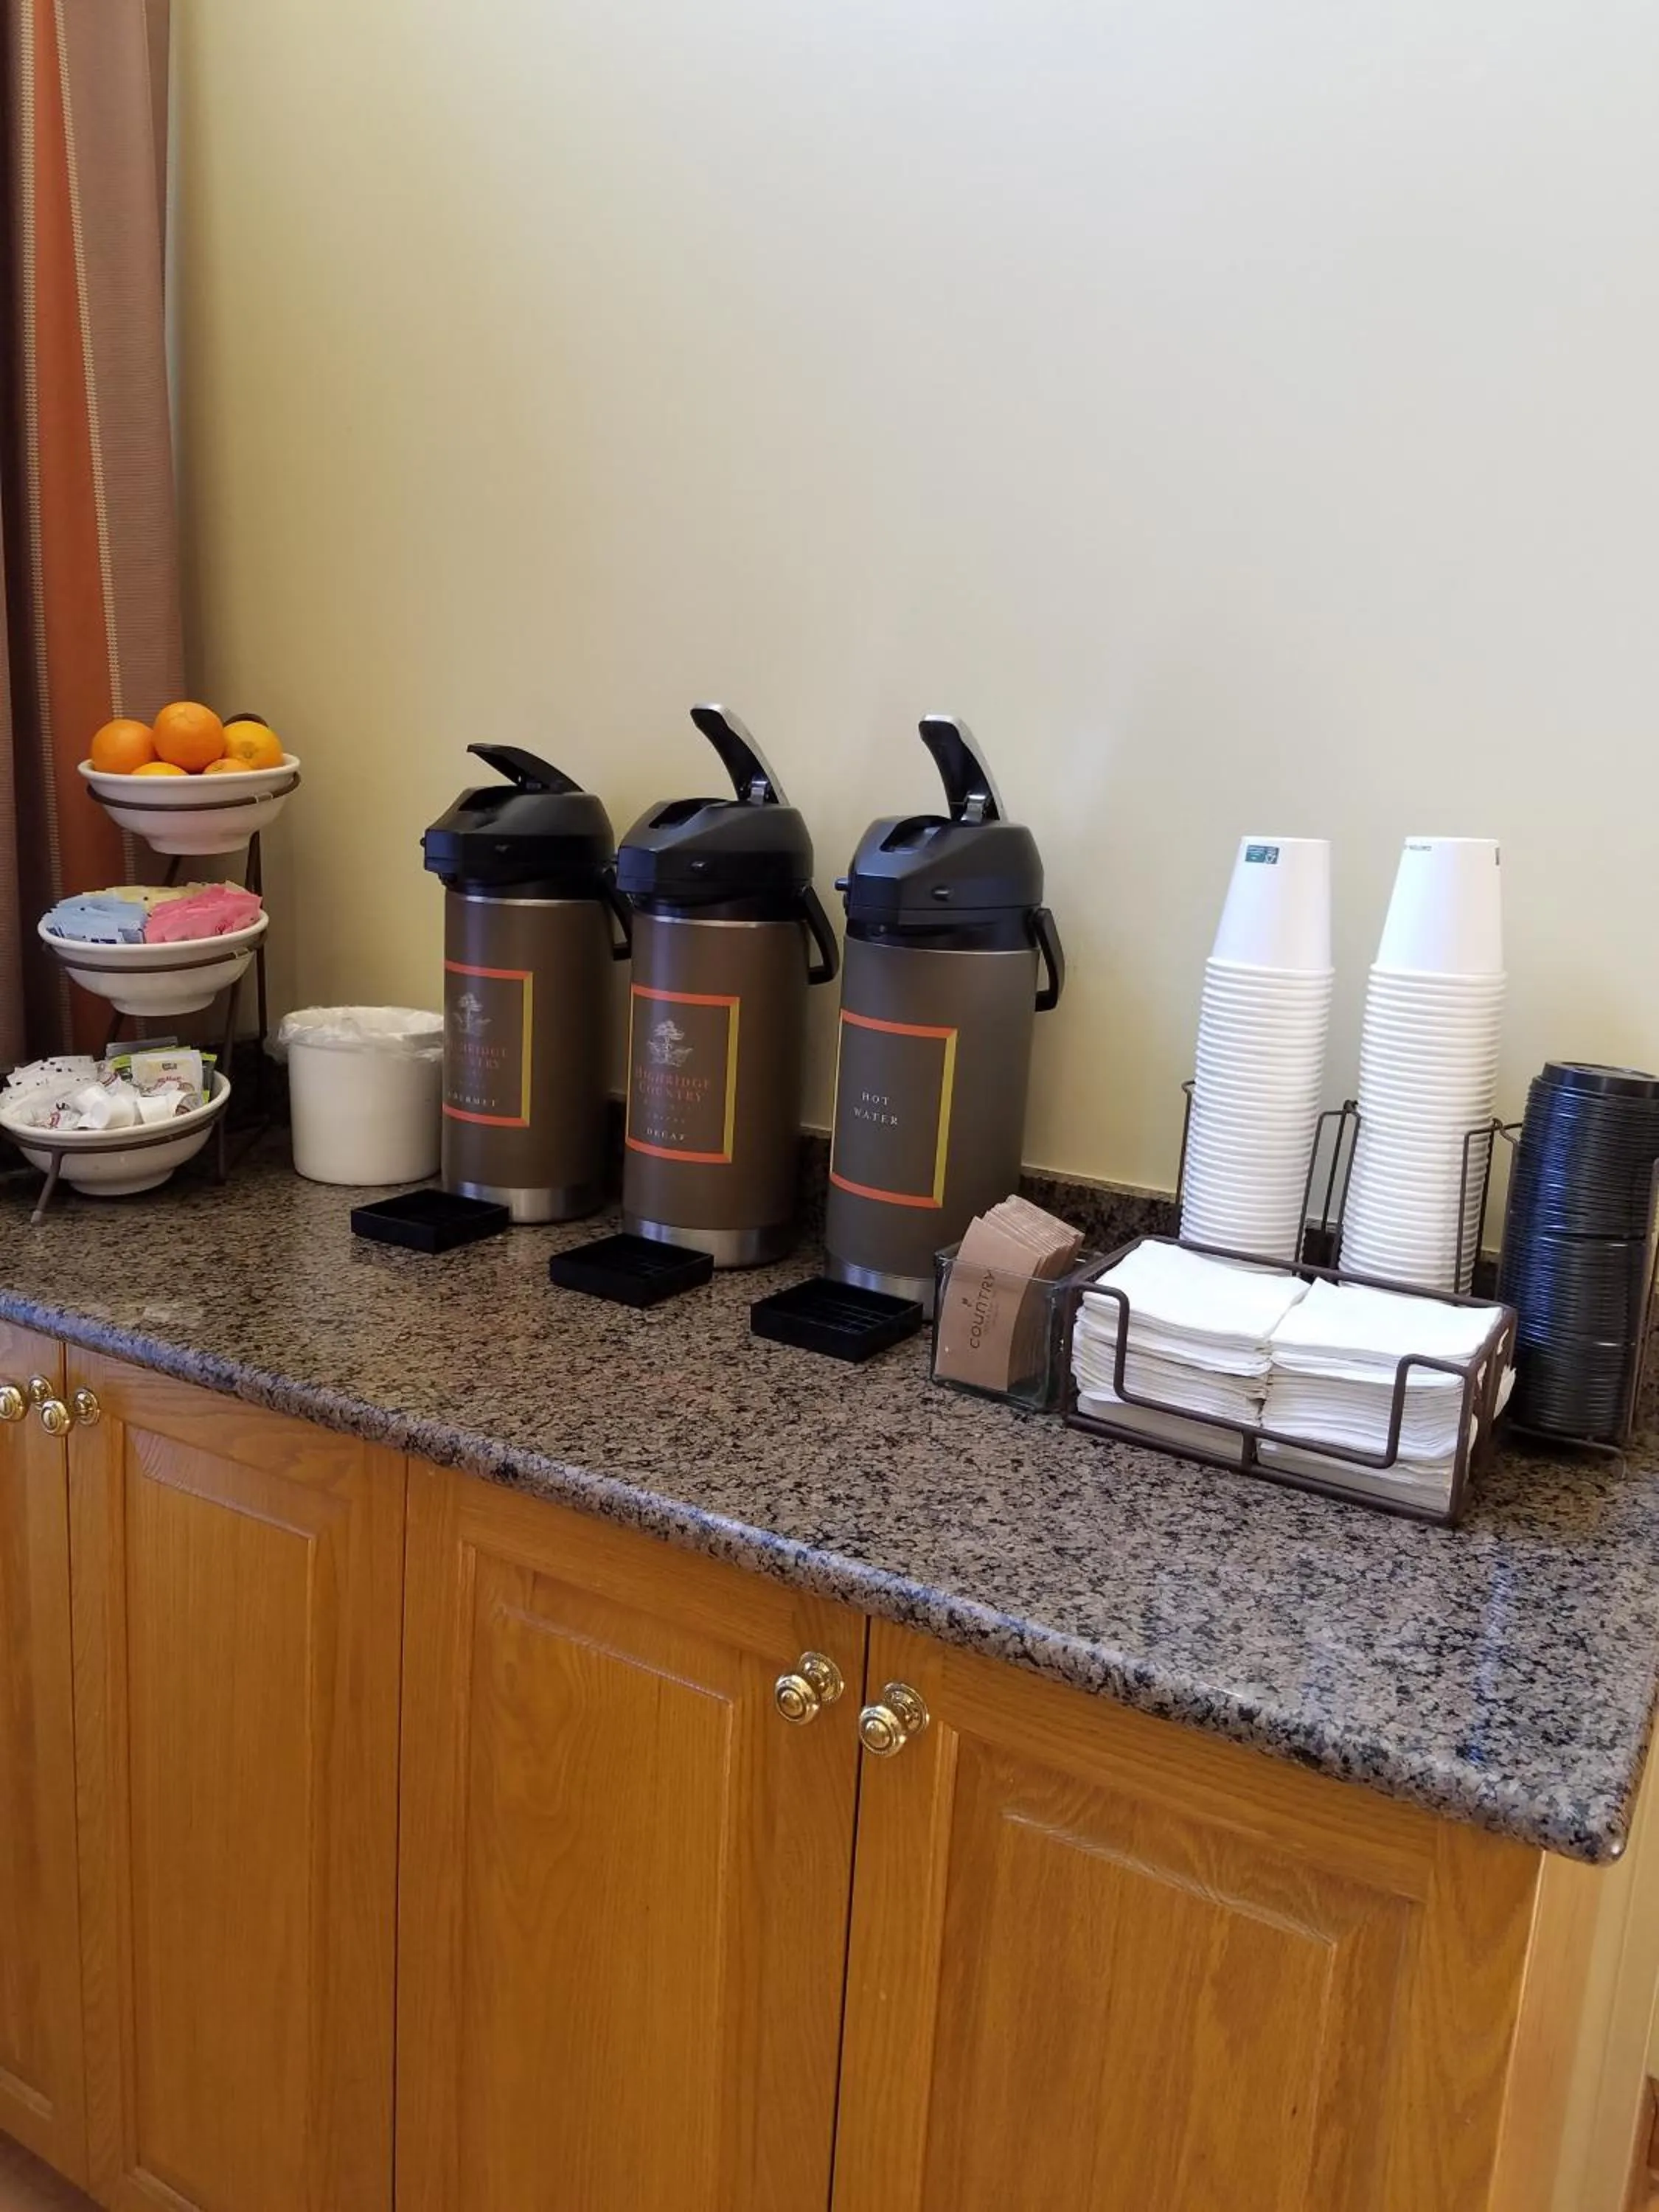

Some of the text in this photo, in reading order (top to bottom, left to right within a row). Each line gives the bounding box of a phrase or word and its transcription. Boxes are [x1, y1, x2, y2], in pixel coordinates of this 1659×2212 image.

[861, 1091, 889, 1105] HOT
[853, 1107, 897, 1125] WATER
[970, 1268, 996, 1349] COUNTRY
